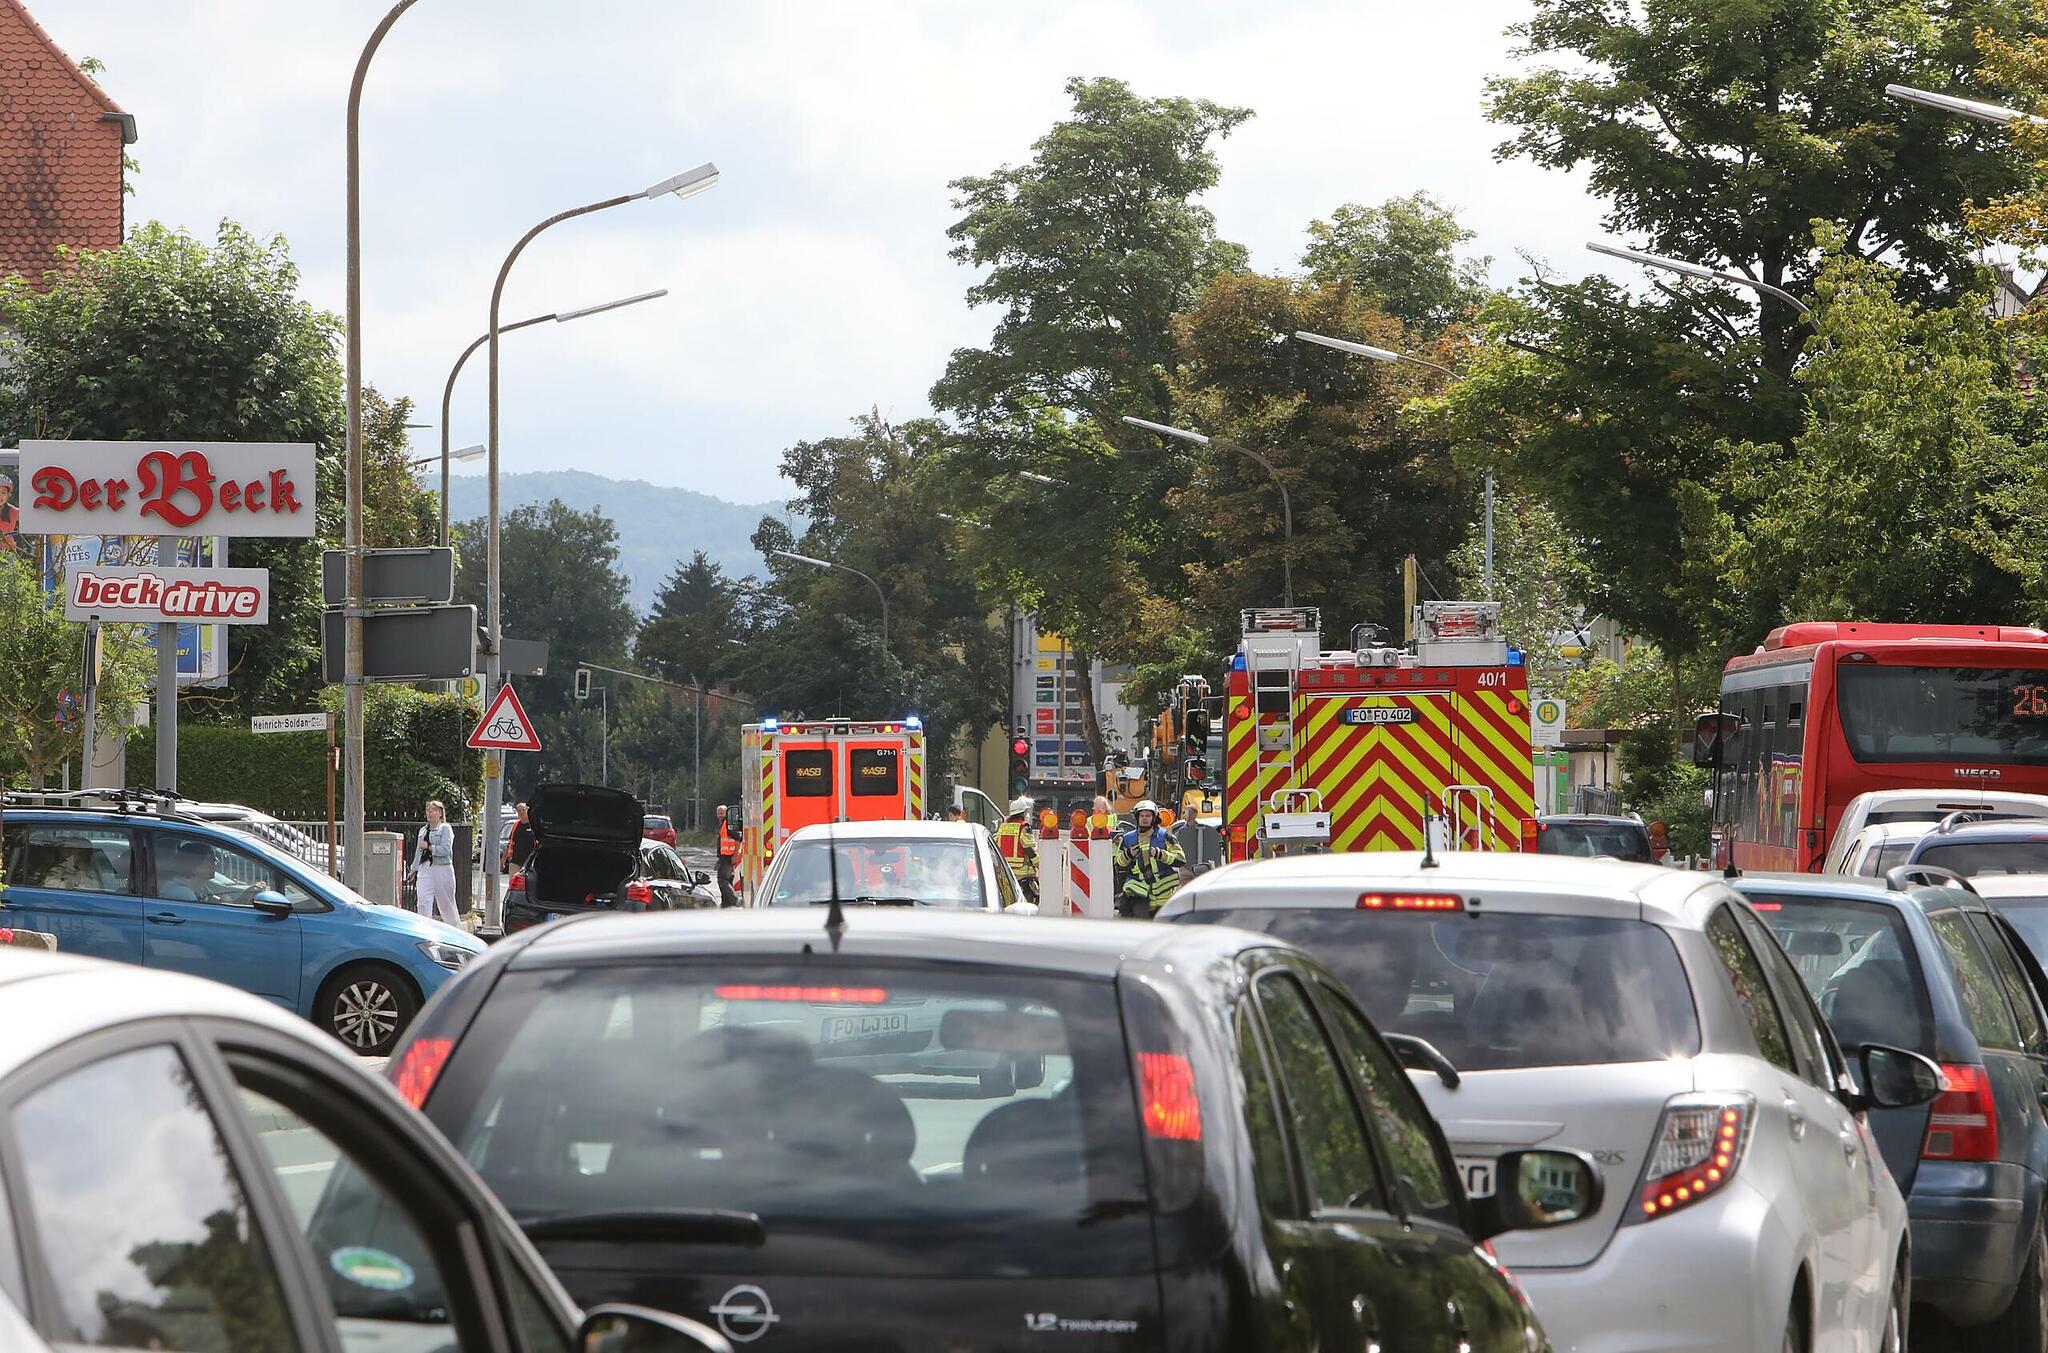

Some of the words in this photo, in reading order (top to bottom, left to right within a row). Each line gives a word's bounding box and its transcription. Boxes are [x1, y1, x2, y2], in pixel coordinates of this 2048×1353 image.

[32, 466, 130, 512] Der
[137, 450, 302, 528] Beck
[1477, 671, 1507, 687] 40/1
[1352, 709, 1367, 721] FO
[1390, 709, 1410, 720] 402
[803, 767, 822, 777] ASB
[868, 766, 887, 776] ASB
[1953, 768, 2001, 779] IVECO
